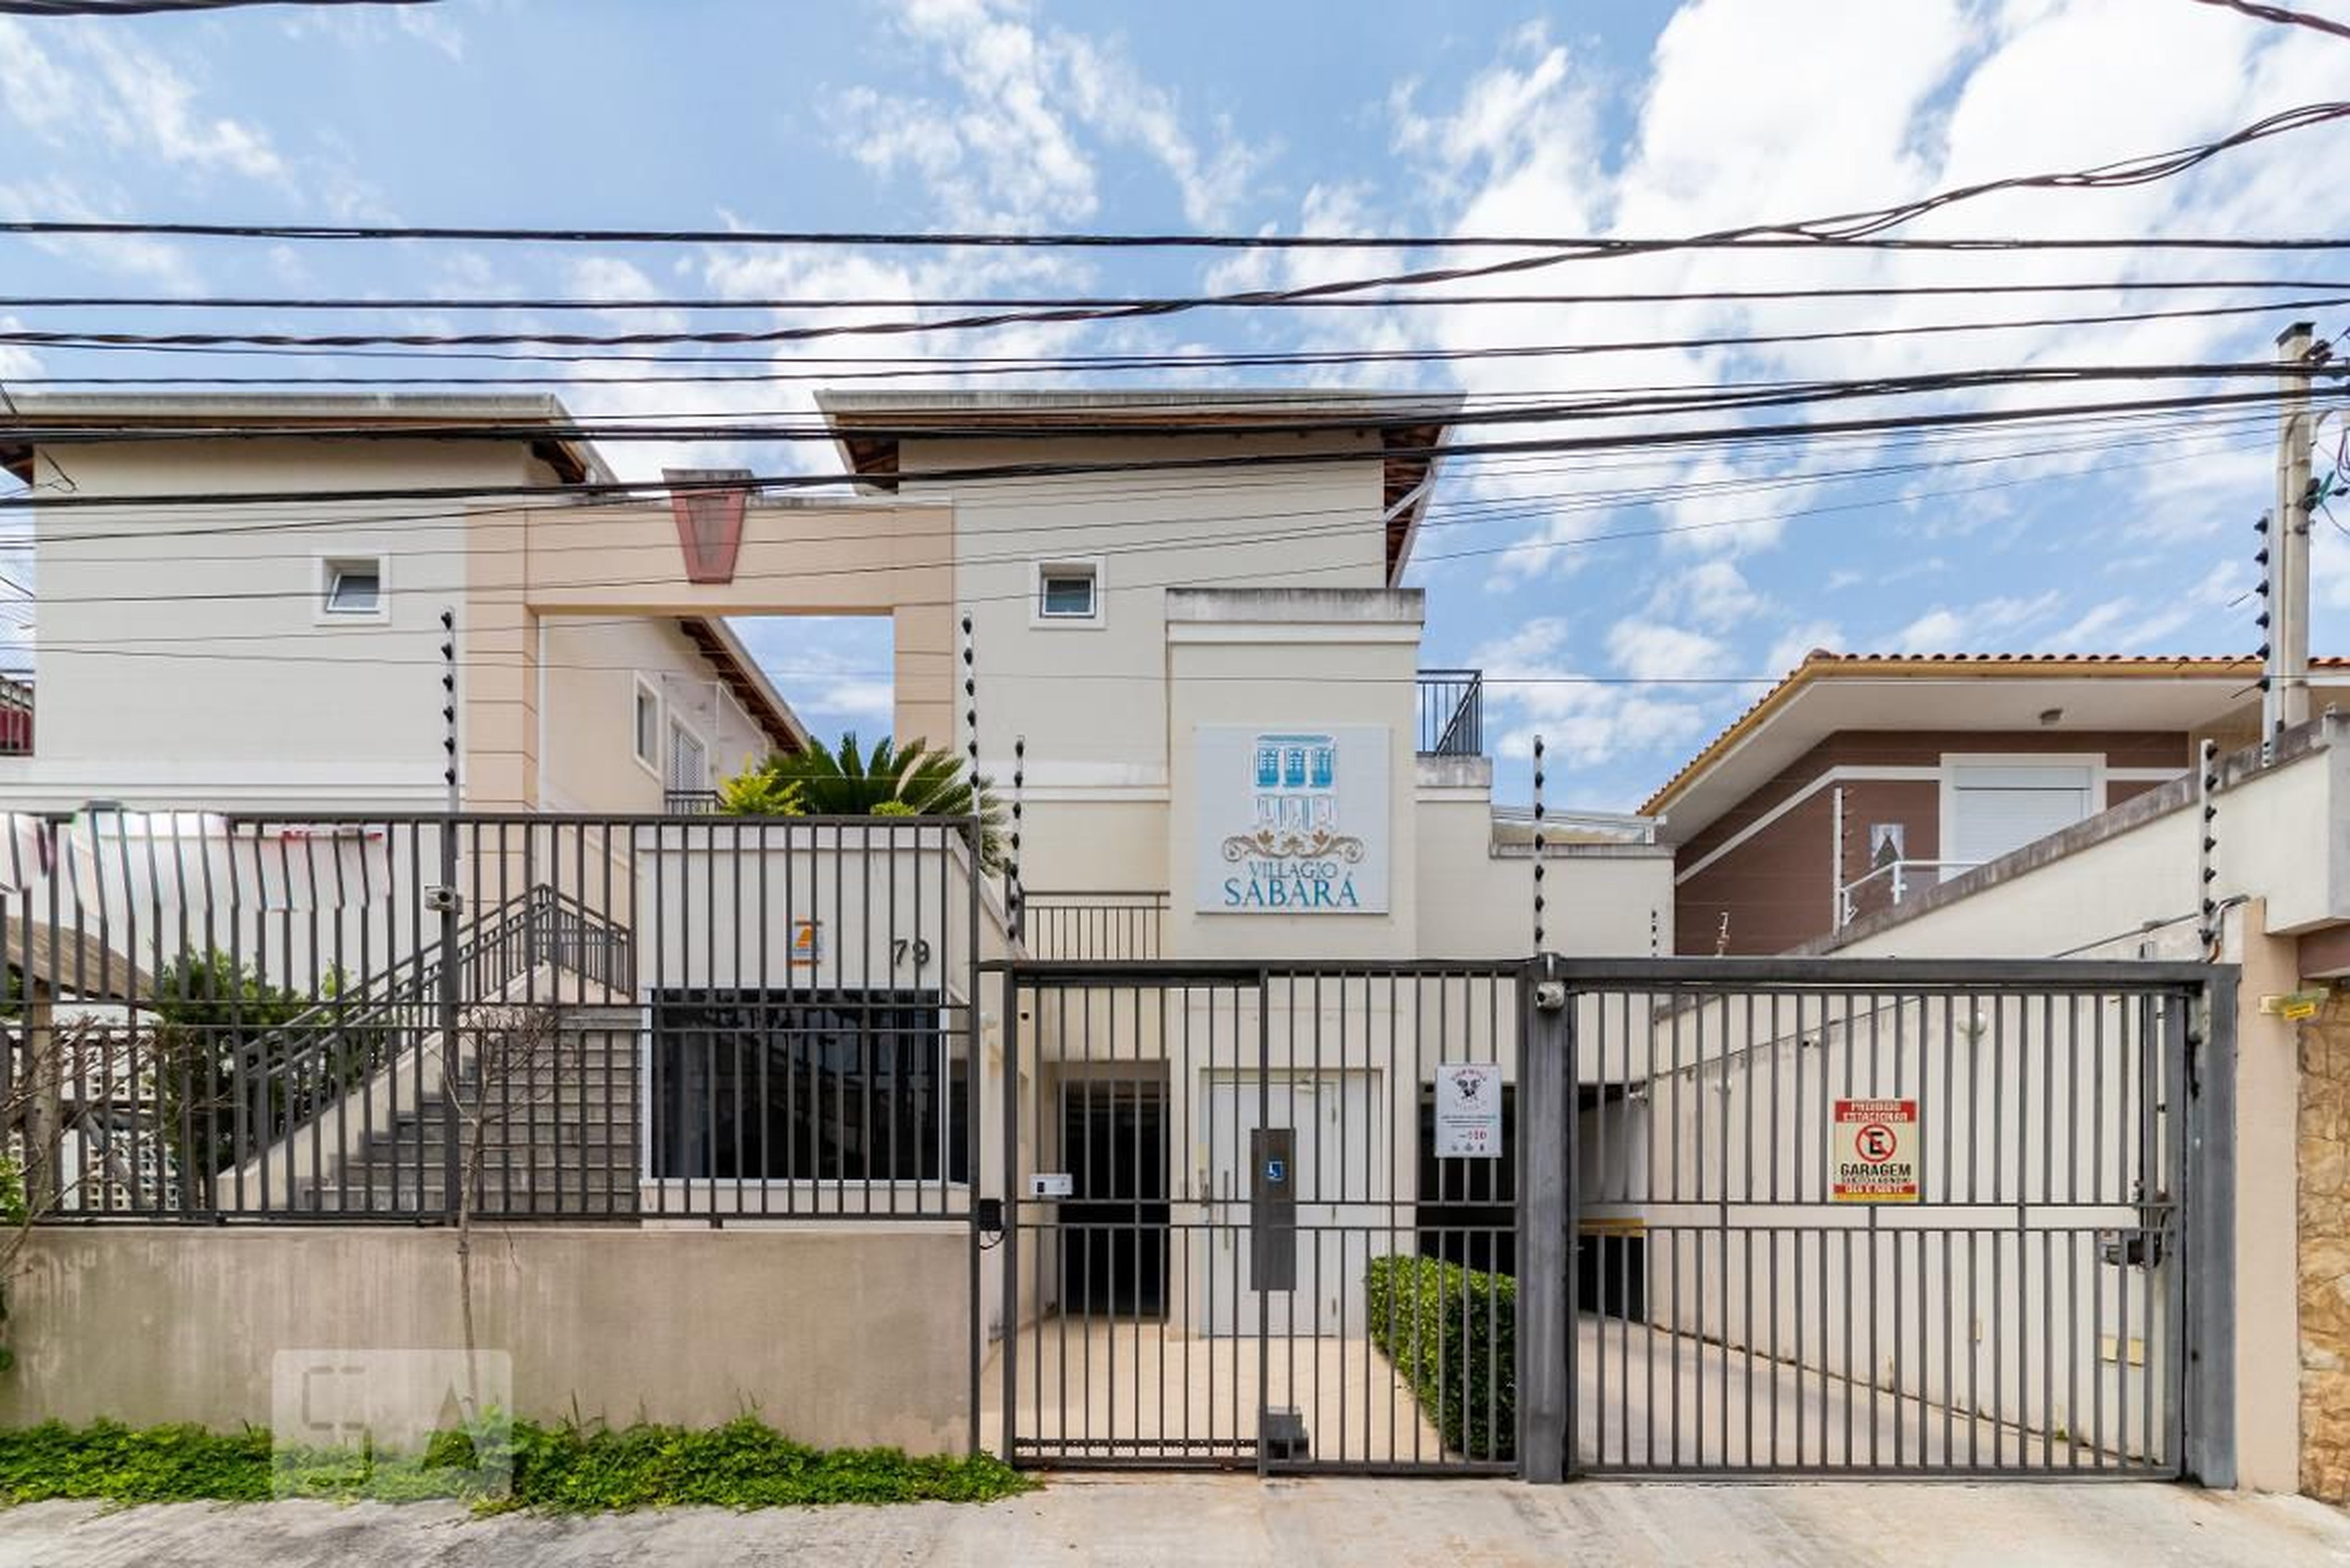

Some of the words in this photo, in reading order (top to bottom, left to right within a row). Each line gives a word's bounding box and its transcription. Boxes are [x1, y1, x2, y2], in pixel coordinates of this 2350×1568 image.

[1249, 861, 1338, 879] VILLAGIO
[1225, 871, 1359, 906] SABARÁ
[893, 939, 930, 966] 79
[1841, 1163, 1911, 1176] GARAGEM
